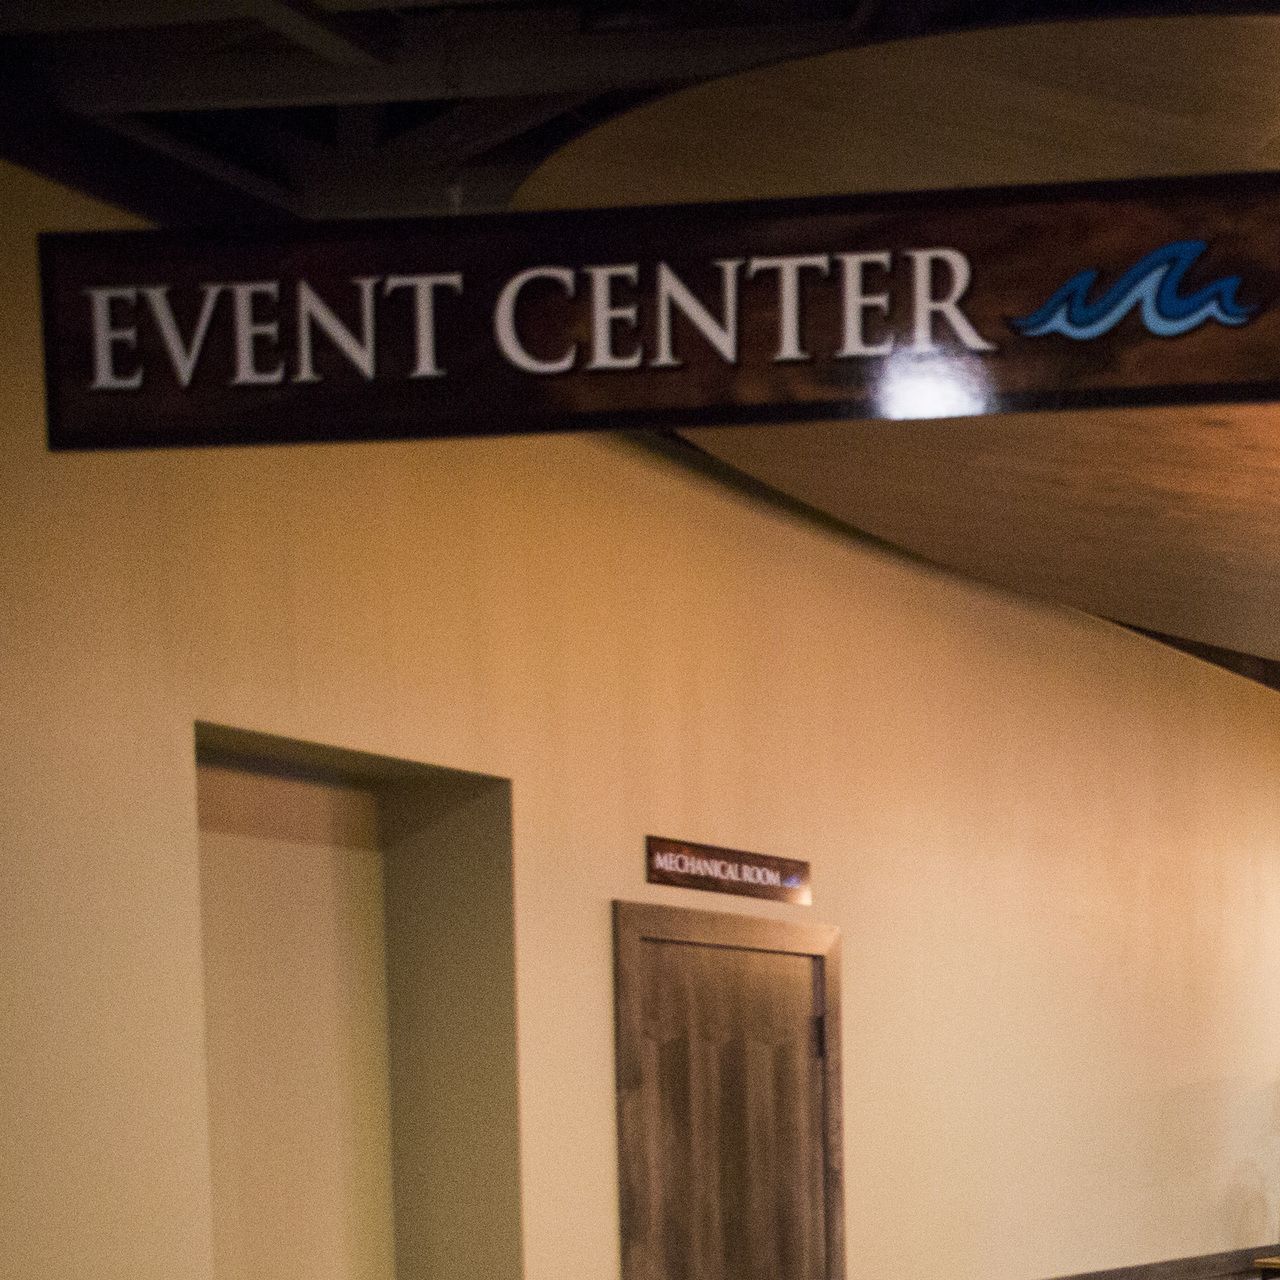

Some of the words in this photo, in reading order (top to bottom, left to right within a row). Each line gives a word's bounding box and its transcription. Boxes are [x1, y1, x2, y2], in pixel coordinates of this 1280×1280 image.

[84, 272, 463, 391] EVENT
[493, 246, 997, 376] CENTER
[742, 864, 782, 887] ROOM
